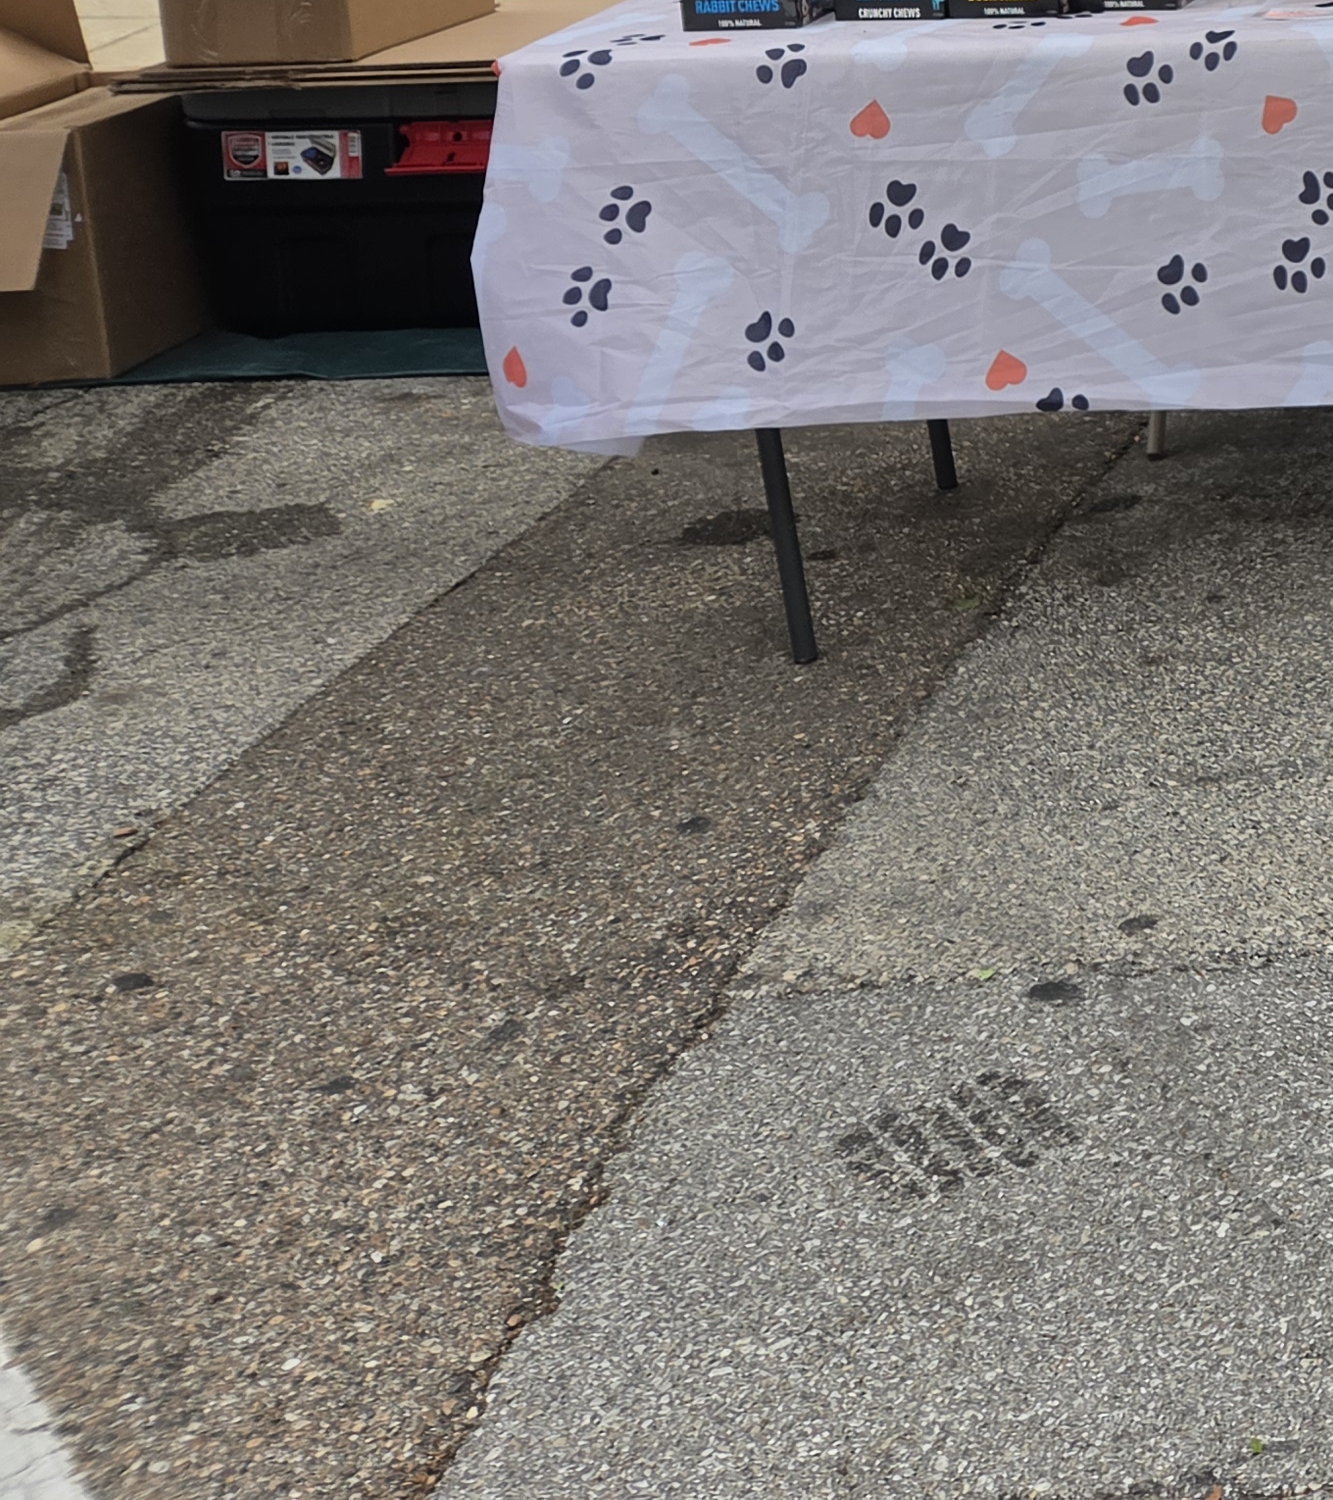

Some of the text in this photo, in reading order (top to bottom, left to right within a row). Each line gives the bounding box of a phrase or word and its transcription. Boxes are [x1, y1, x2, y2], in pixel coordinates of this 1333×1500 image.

[695, 0, 735, 14] RABBIT
[858, 7, 921, 18] CRUNCHY CHEWS
